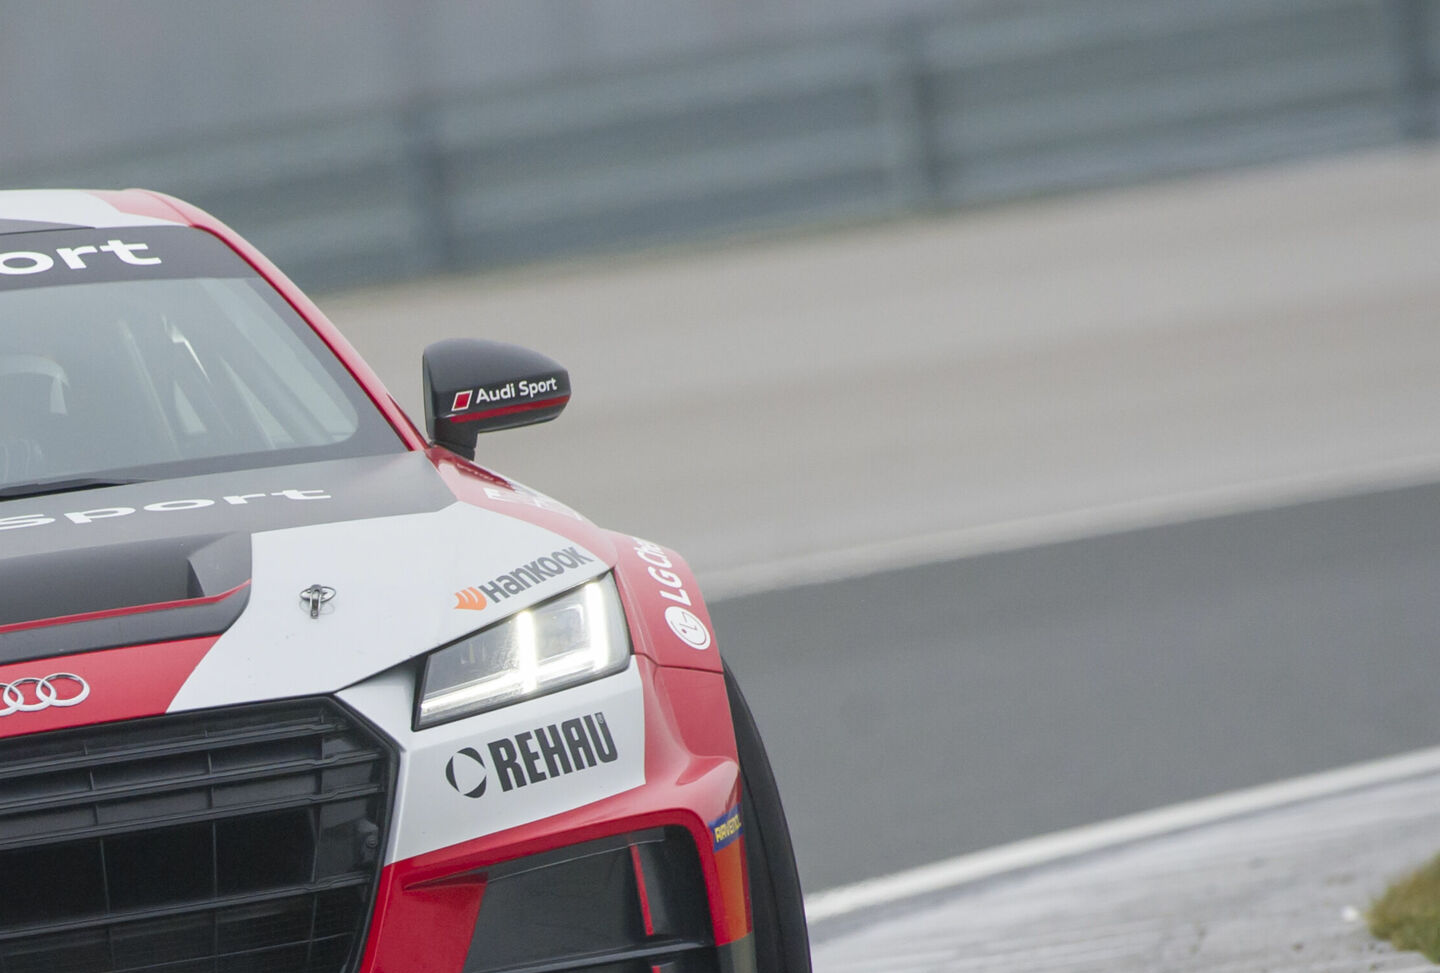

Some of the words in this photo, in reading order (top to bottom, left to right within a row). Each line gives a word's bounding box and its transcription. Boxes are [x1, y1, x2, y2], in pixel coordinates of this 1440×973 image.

[476, 383, 516, 404] Audi
[518, 377, 558, 398] Sport
[647, 566, 692, 607] LG
[486, 711, 620, 793] REHAU
